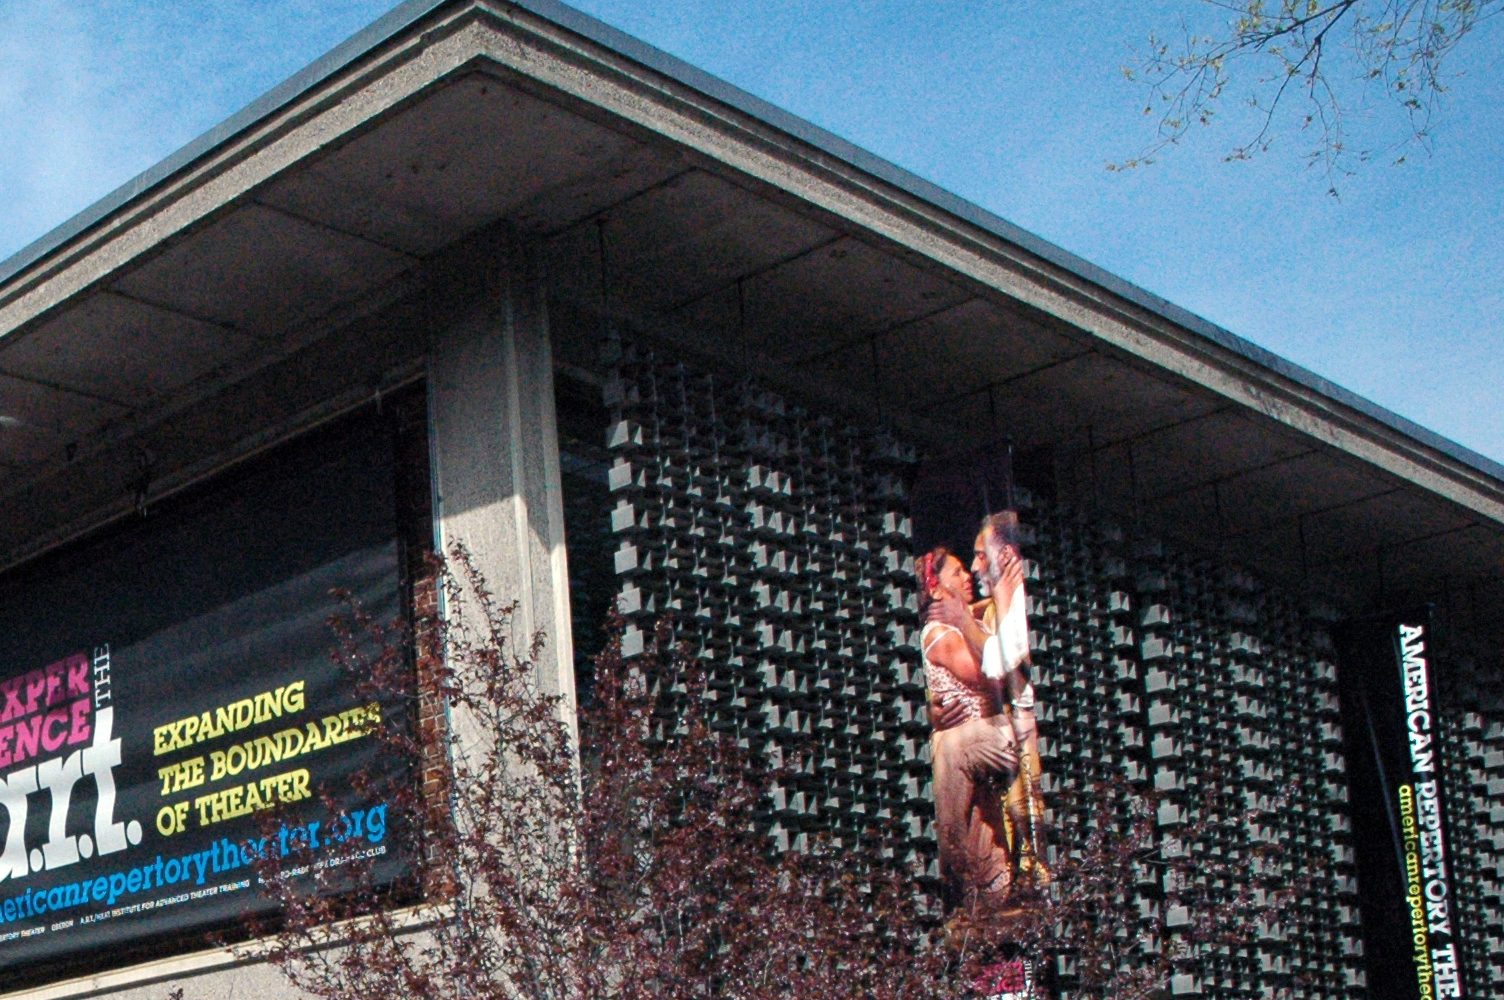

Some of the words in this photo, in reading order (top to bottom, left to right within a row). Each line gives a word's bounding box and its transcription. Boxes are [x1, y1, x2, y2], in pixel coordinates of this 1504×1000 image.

[94, 643, 111, 708] THE
[153, 680, 305, 756] EXPANDING
[1399, 624, 1435, 773] AMERICAN
[158, 757, 205, 796] THE
[210, 701, 381, 782] BOUNDARIES
[156, 801, 189, 836] OF
[195, 768, 311, 827] THEATER
[1415, 779, 1451, 936] REPERTORY
